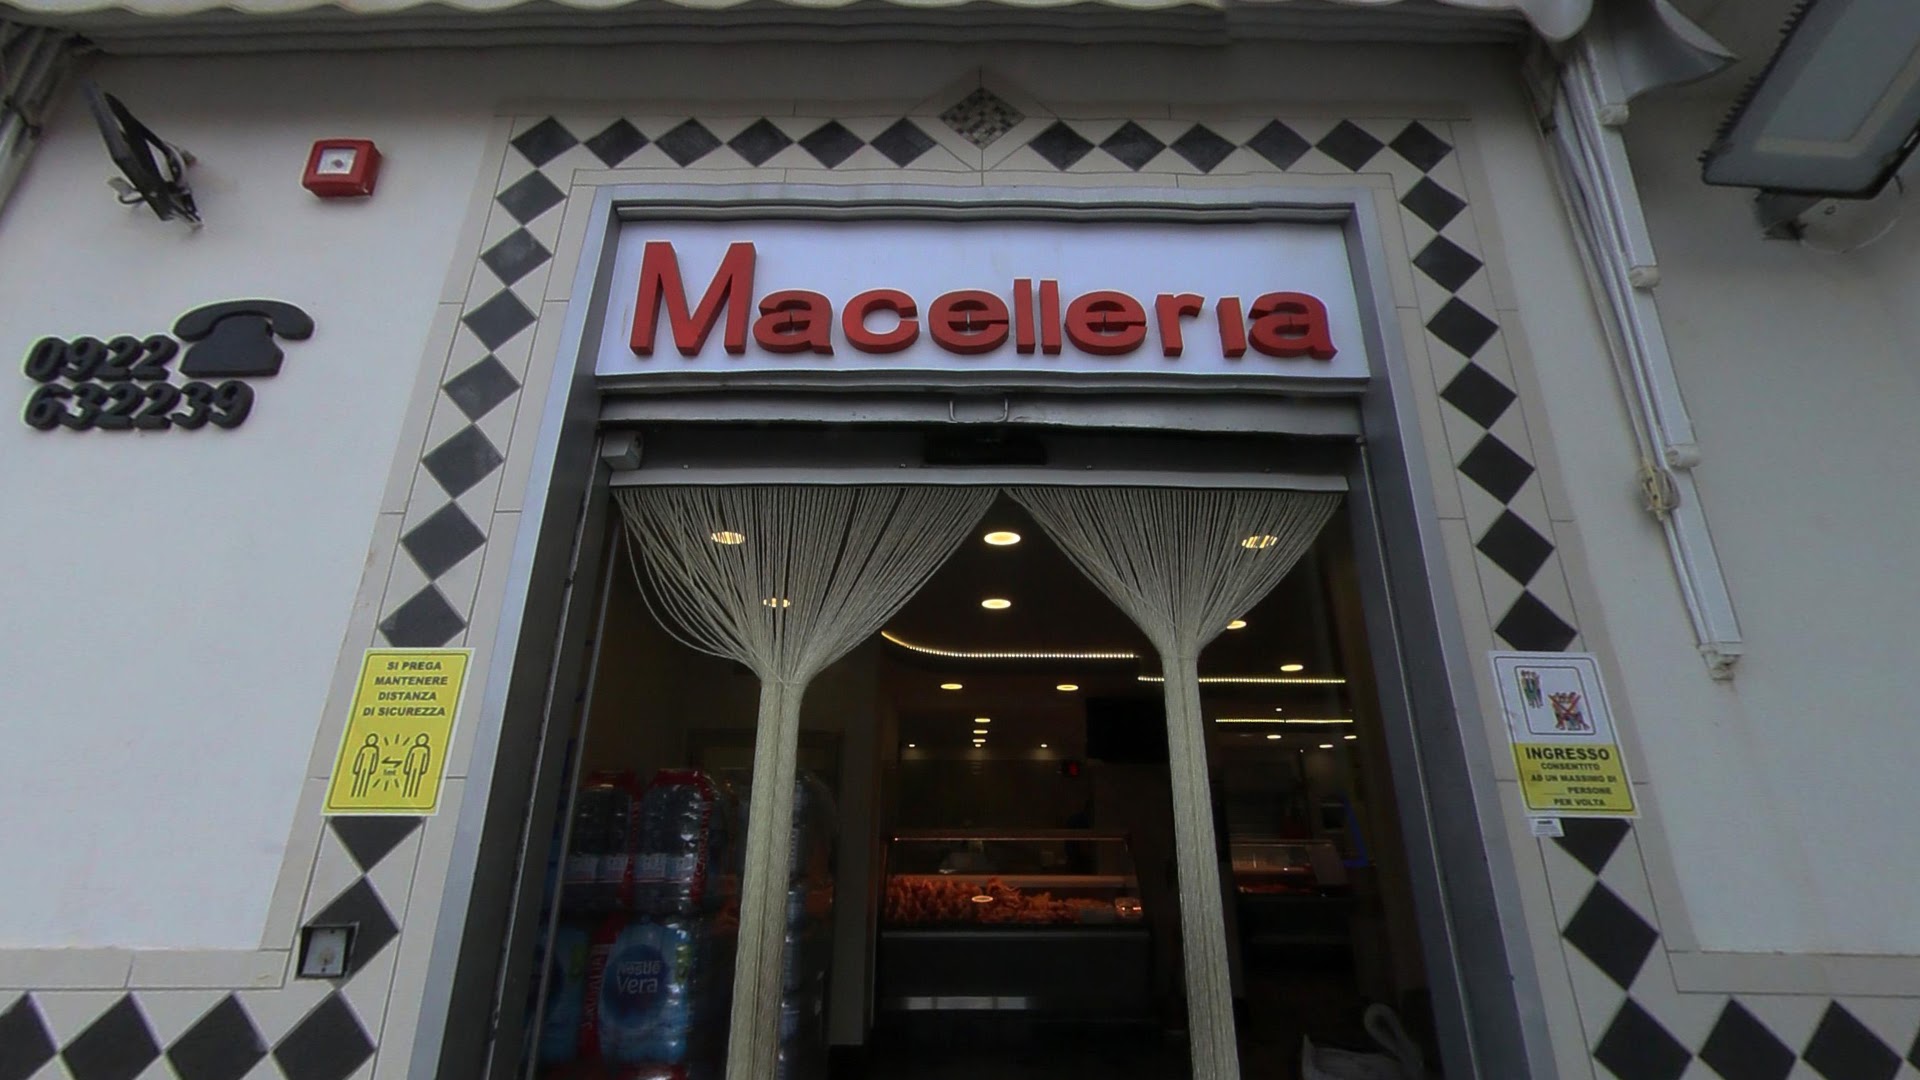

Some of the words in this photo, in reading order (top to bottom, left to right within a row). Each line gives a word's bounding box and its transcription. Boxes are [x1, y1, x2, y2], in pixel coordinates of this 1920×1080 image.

[629, 241, 1338, 360] Macelleria
[24, 334, 179, 383] 0922
[23, 380, 255, 432] 632239
[387, 662, 399, 670] SI
[402, 662, 441, 670] PREGA
[375, 676, 448, 685] MANTENERE
[378, 691, 437, 700] DISTANZA
[363, 707, 375, 716] DI
[378, 707, 445, 716] SICUREZZA
[1526, 747, 1610, 760] INGRESSO
[1540, 762, 1601, 771] CONSENTITO
[1545, 773, 1558, 782] UN
[1560, 774, 1605, 783] MASSIMO
[1567, 786, 1612, 795] PERSONE
[1553, 797, 1572, 806] PER
[1574, 798, 1607, 807] VOLTA
[616, 976, 658, 994] Vera
